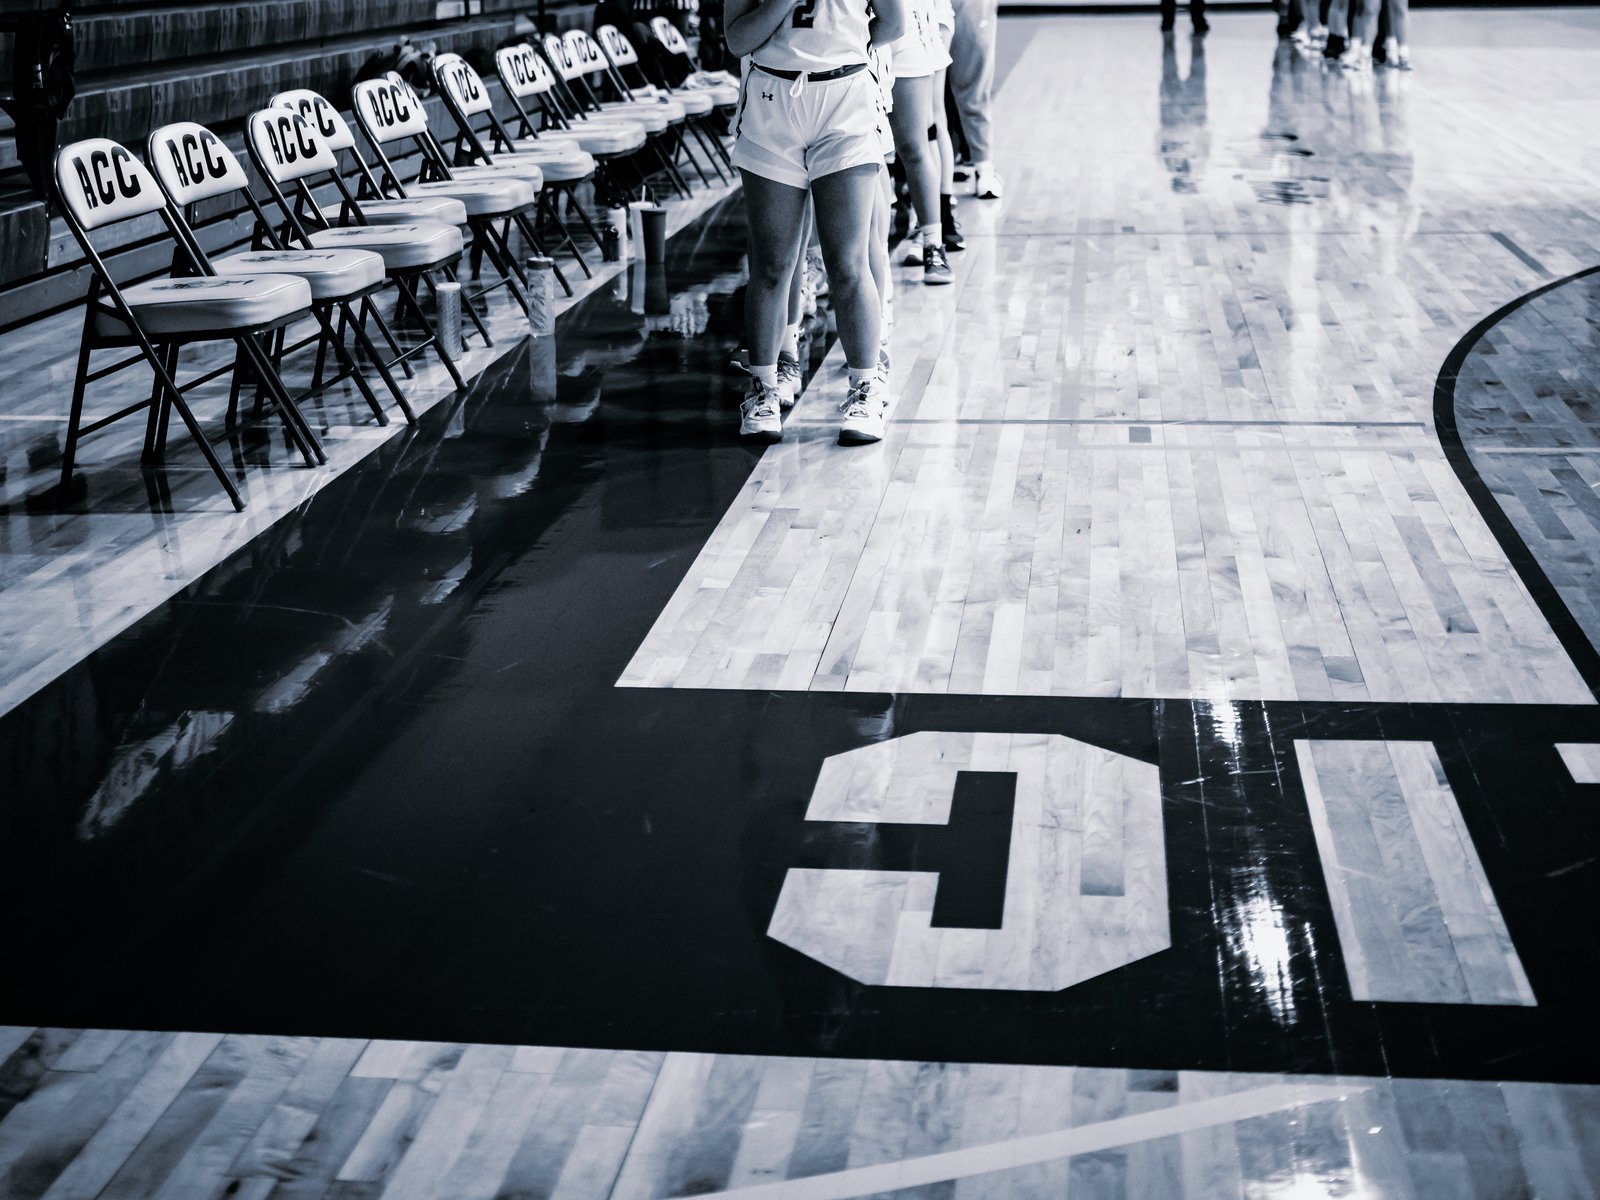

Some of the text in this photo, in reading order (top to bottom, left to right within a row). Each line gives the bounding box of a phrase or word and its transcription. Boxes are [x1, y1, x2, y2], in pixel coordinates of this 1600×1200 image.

[366, 85, 411, 127] ACC
[165, 130, 228, 187] ACC
[263, 114, 318, 165] ACC
[72, 146, 141, 210] ACC
[766, 730, 1600, 1006] IC
